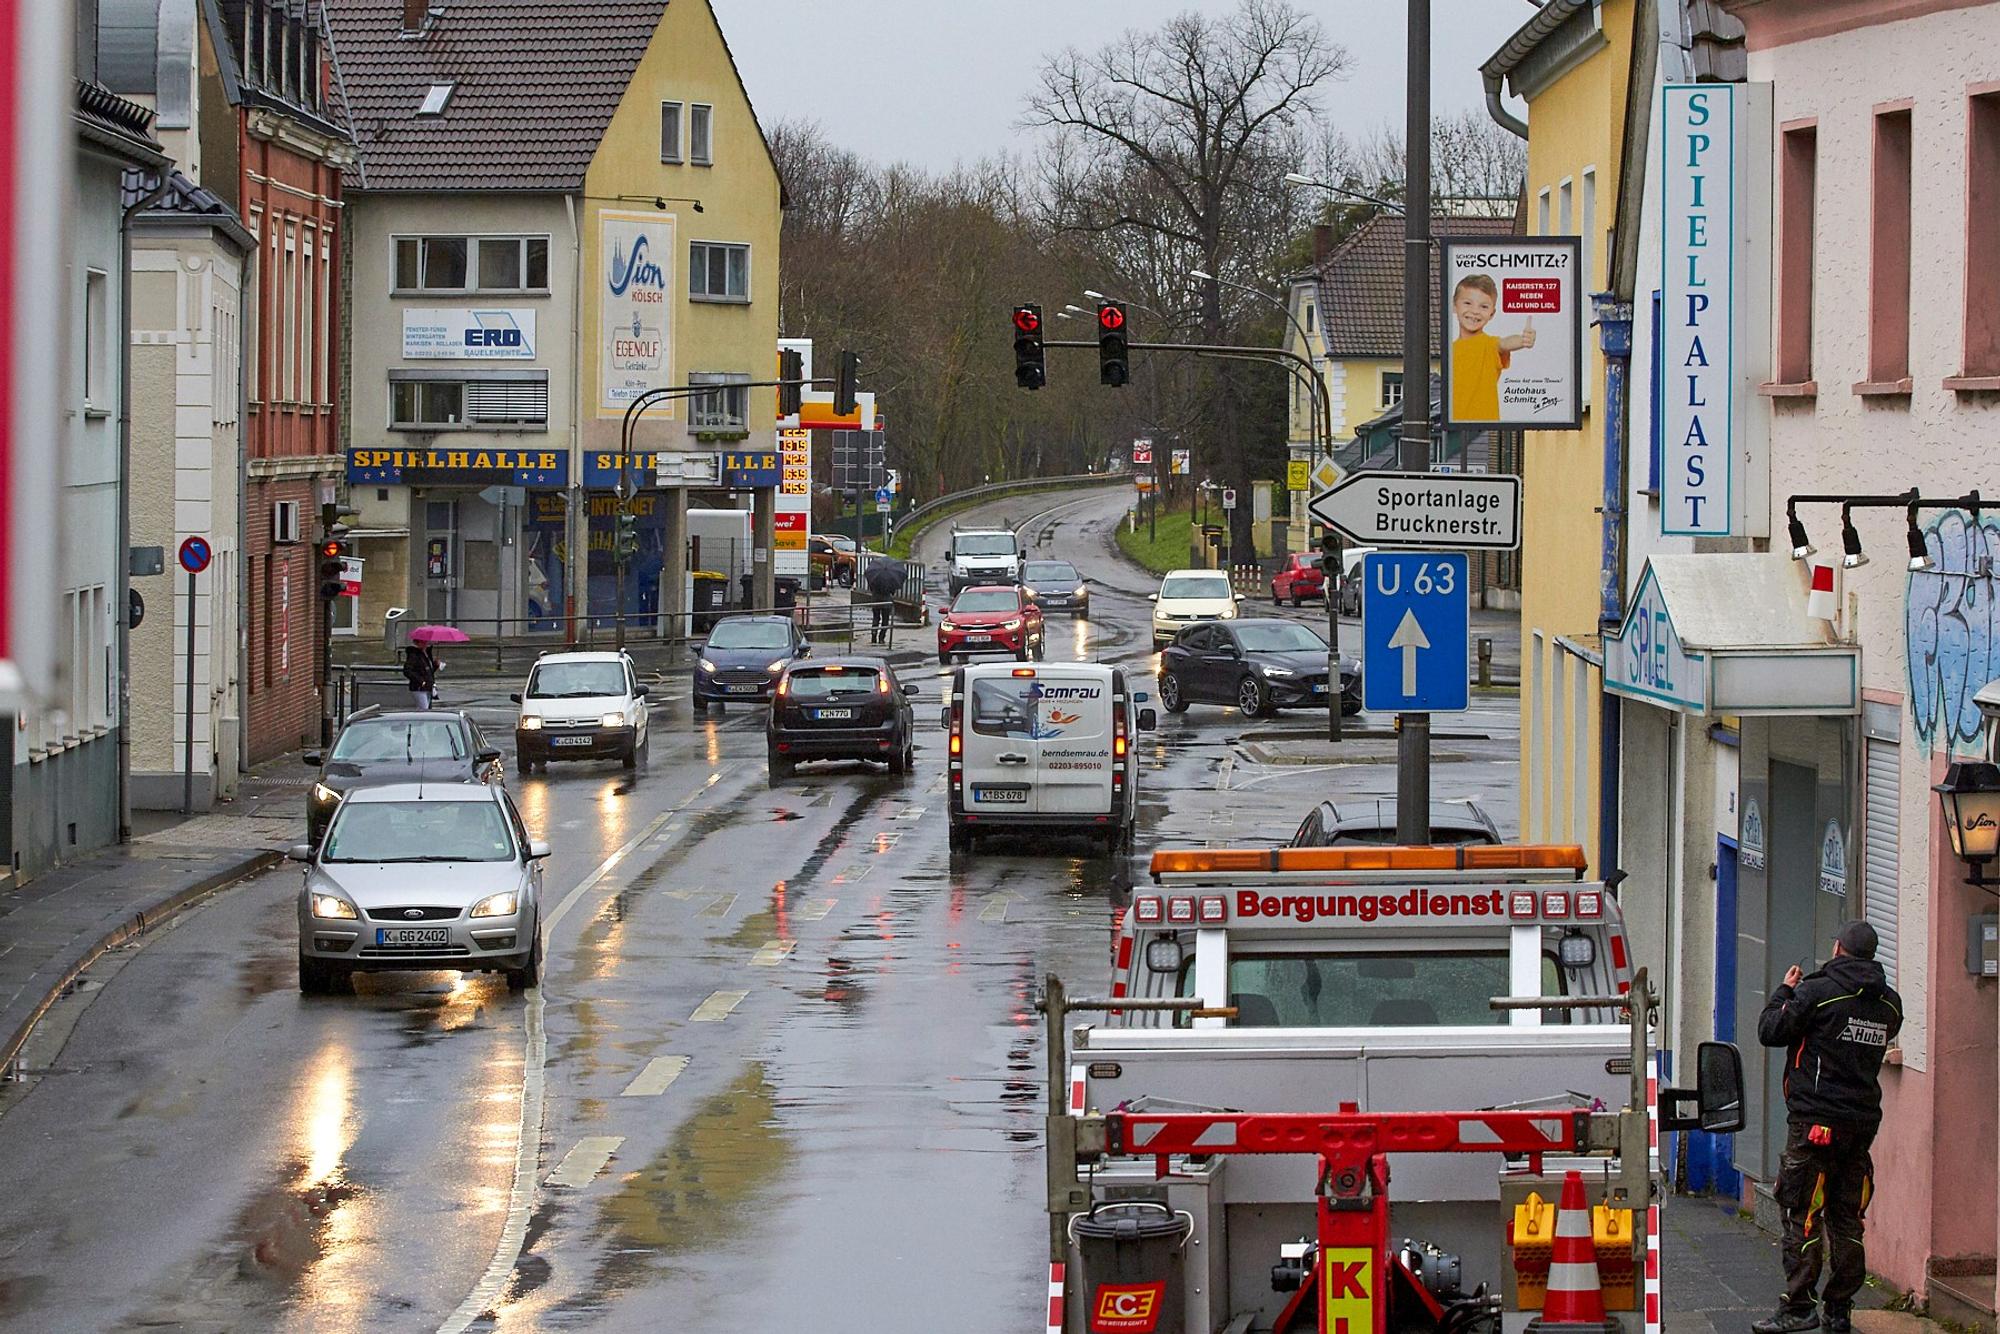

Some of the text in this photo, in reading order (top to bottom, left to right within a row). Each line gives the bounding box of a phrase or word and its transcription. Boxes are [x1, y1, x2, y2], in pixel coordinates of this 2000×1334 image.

[608, 234, 665, 296] Sion
[632, 289, 663, 303] KÖLSCH
[1683, 93, 1710, 528] SPIELPALAST
[464, 349, 521, 357] BAUELEMENTE
[616, 340, 659, 358] EGENOLF
[1503, 395, 1537, 403] Schmitz
[1504, 387, 1547, 395] Autohaus
[353, 450, 776, 470] SPIELHALLE SPIELLE
[1377, 487, 1500, 513] Sportanlage
[1376, 513, 1502, 536] Brucknerstr.
[1377, 562, 1455, 596] U 63
[1629, 598, 1673, 691] SPIEL
[1020, 683, 1101, 698] Semrau
[1042, 749, 1109, 757] berndsemrau.de
[982, 791, 1022, 799] K BS 678
[1236, 889, 1504, 922] Bergungsdienst
[384, 931, 446, 942] K GG 2402
[1855, 1028, 1883, 1044] Hube
[1101, 1293, 1154, 1316] ACE
